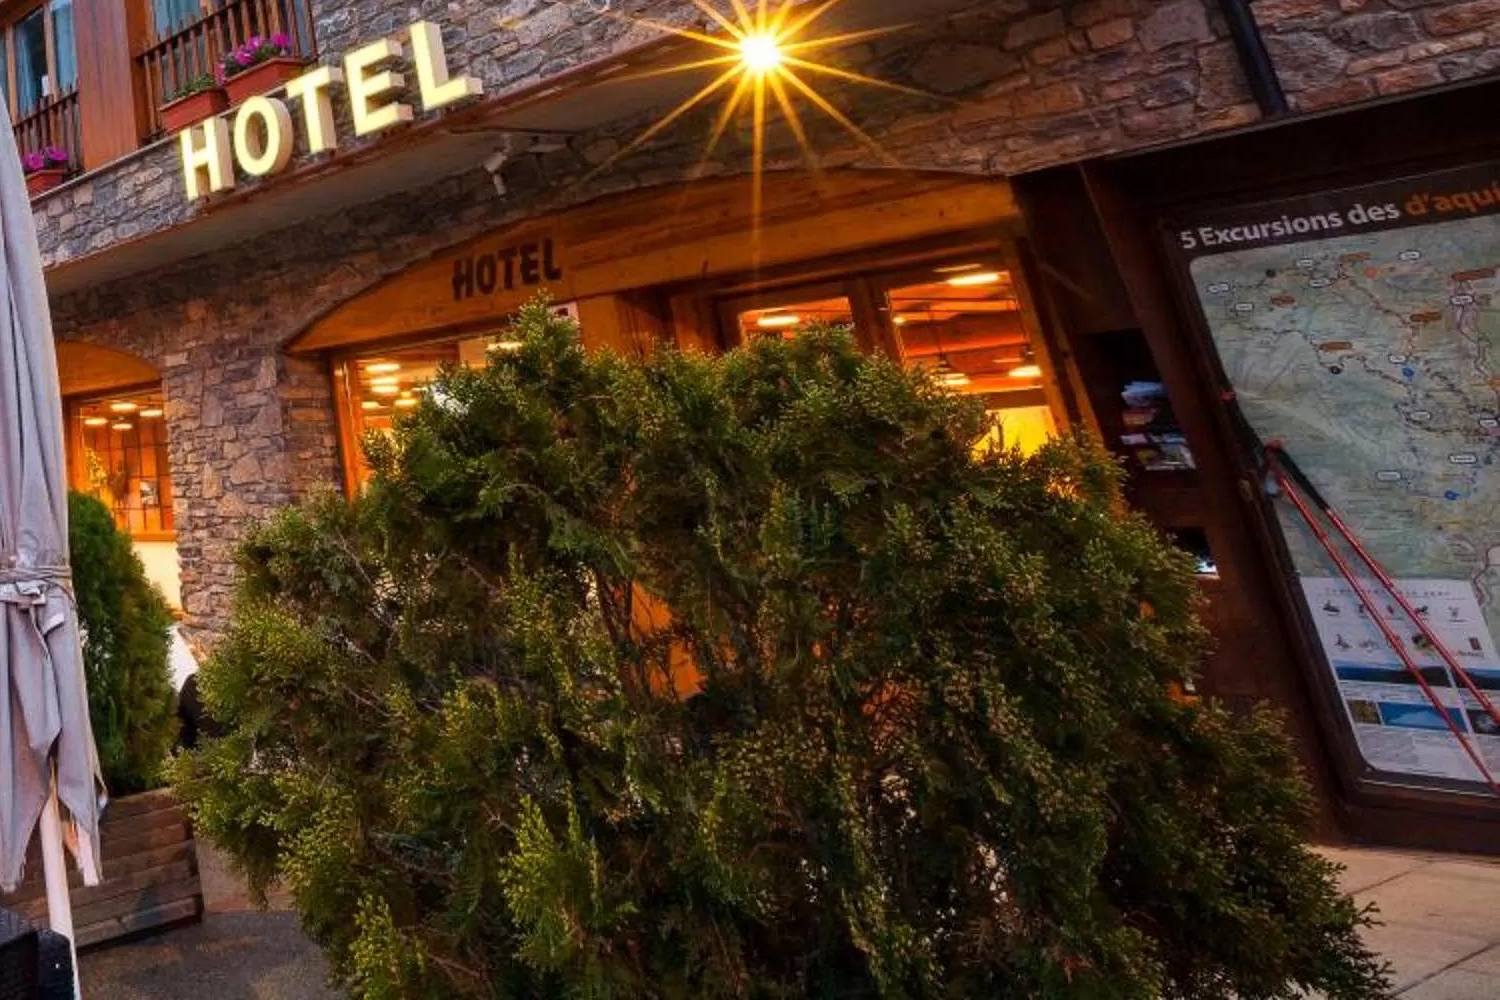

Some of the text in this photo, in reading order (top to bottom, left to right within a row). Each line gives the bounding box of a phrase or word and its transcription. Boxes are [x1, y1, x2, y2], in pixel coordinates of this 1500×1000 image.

[177, 20, 484, 201] HOTEL
[1181, 230, 1197, 249] 5
[1202, 213, 1344, 246] Excursions
[1348, 201, 1400, 224] des
[452, 239, 563, 300] HOTEL
